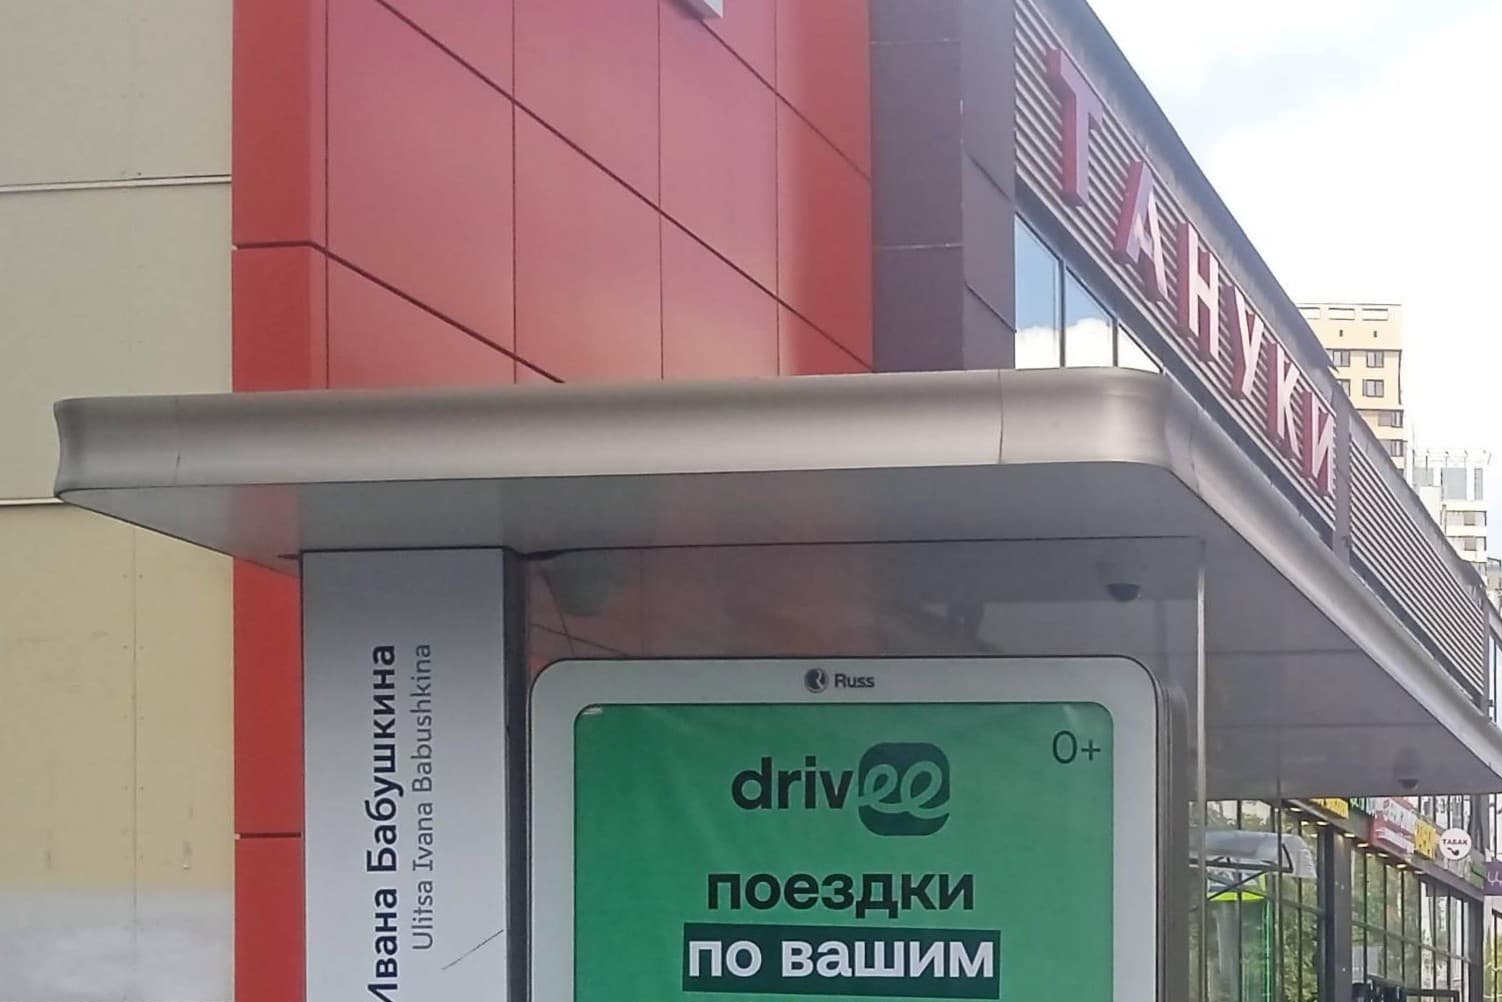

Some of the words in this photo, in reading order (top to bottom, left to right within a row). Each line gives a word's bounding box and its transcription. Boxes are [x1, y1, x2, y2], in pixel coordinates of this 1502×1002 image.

[1045, 47, 1335, 498] ТАНУКИ
[834, 673, 876, 690] Russ
[409, 643, 433, 793] Babushkina
[1051, 729, 1102, 766] 0+
[364, 644, 404, 873] Бабушкина
[730, 754, 951, 821] drivee
[412, 801, 434, 872] Ivana
[411, 880, 434, 950] Ulitsa
[706, 871, 976, 920] поездки
[687, 938, 763, 979] по
[780, 939, 995, 980] вашим
